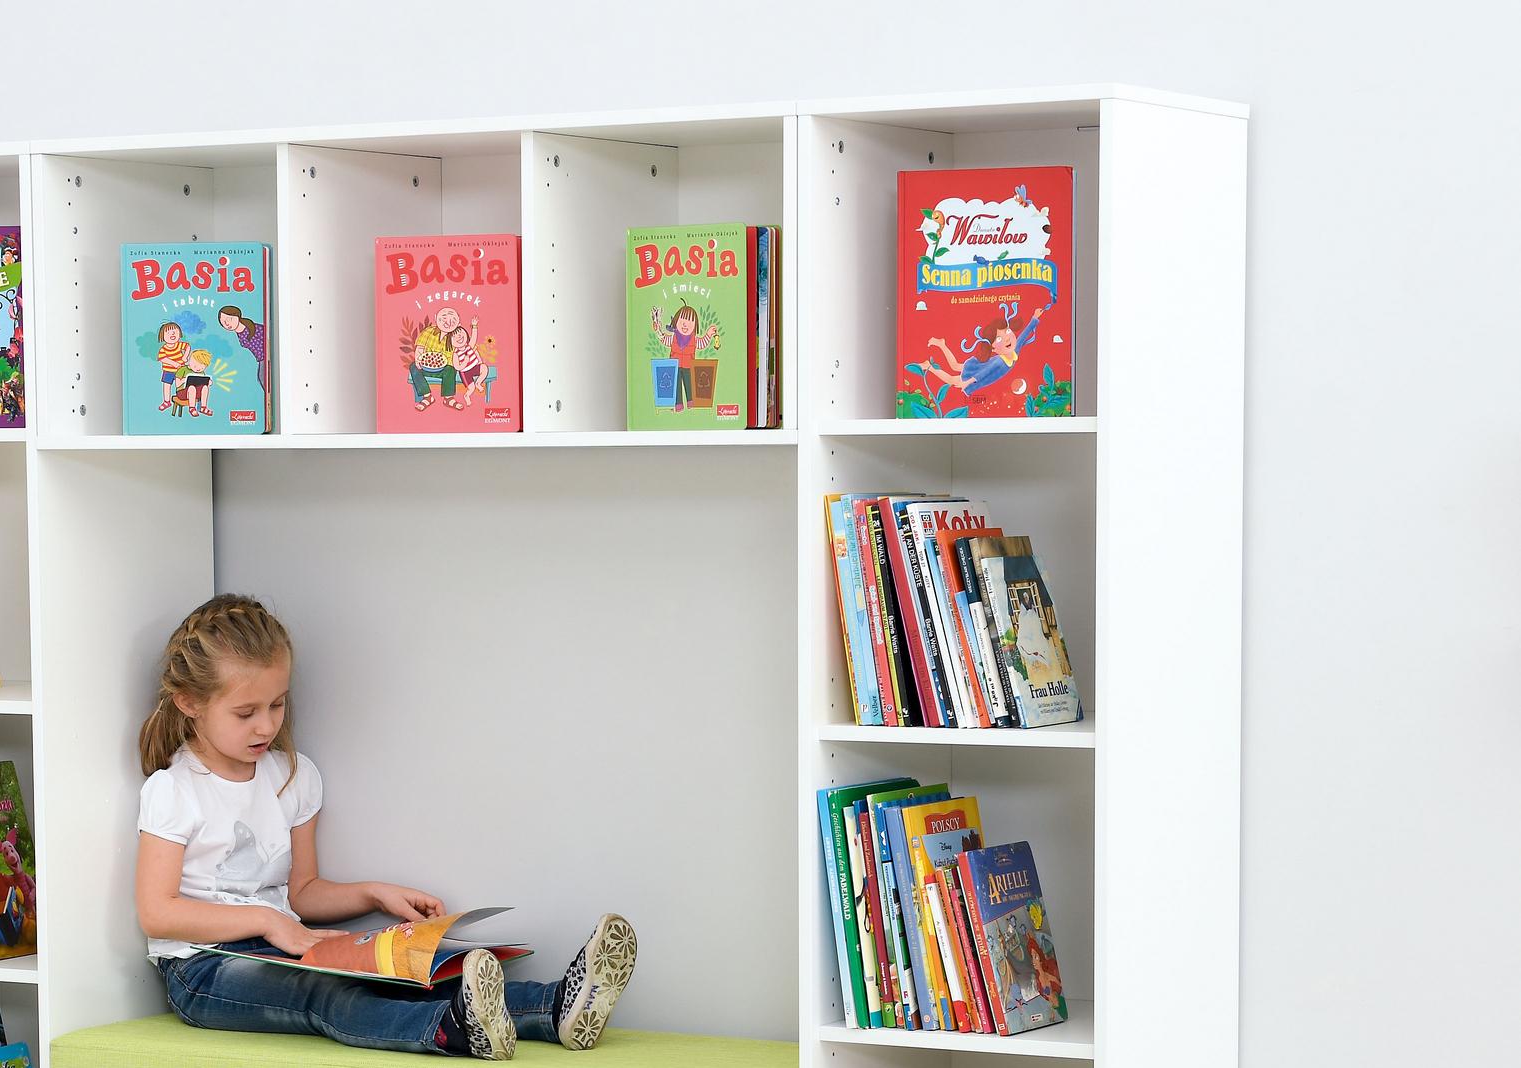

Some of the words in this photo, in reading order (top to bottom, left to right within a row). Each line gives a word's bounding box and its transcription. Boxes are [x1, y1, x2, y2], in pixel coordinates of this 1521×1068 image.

[386, 248, 510, 295] Basia
[635, 239, 739, 289] Basia
[922, 264, 972, 287] Senna
[977, 260, 1053, 288] piosenka
[131, 256, 256, 301] Basia
[427, 291, 481, 307] zegarek
[673, 282, 712, 299] śmieci
[951, 296, 958, 304] do
[959, 294, 998, 304] samodzielnego
[999, 293, 1021, 302] czytania
[174, 295, 215, 308] tablet
[934, 510, 986, 530] Koty
[878, 543, 887, 564] WALD
[909, 549, 918, 564] DER
[913, 565, 922, 587] KÜSTE
[1029, 684, 1049, 699] Frau
[1047, 681, 1070, 696] Holle
[931, 818, 960, 834] POLSCY
[840, 873, 851, 919] FABELWALD
[989, 870, 1032, 906] ARIELLE
